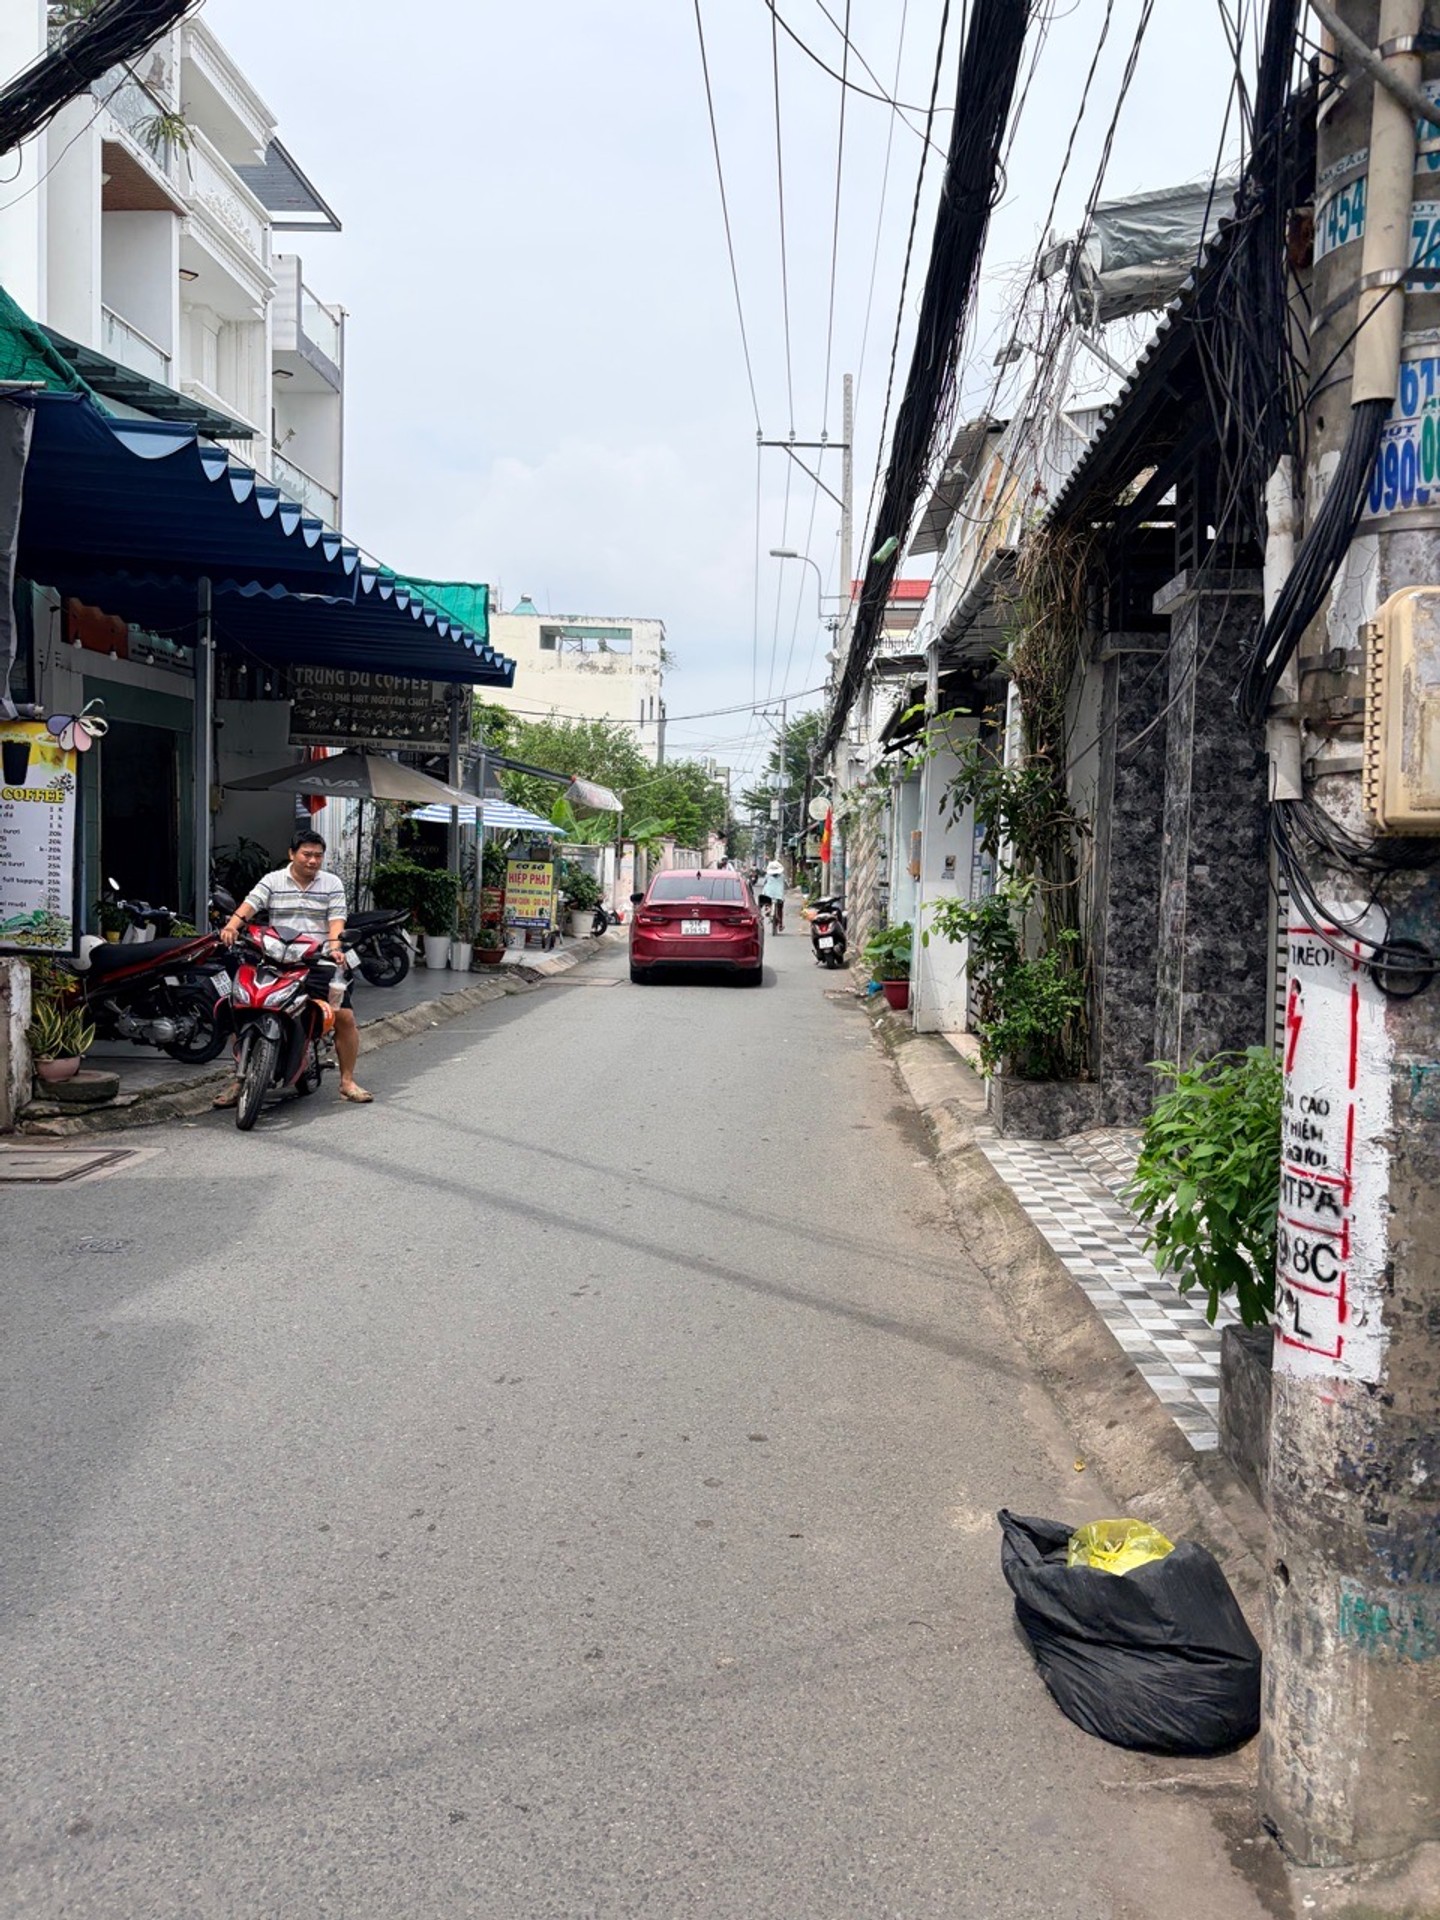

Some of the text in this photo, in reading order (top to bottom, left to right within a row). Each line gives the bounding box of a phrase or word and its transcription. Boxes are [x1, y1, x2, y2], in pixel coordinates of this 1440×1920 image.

[295, 667, 429, 690] TRUNG DU COFFEE
[2, 787, 65, 803] COFFEE
[508, 870, 527, 887] HIỆP
[1300, 1095, 1330, 1116] CAO
